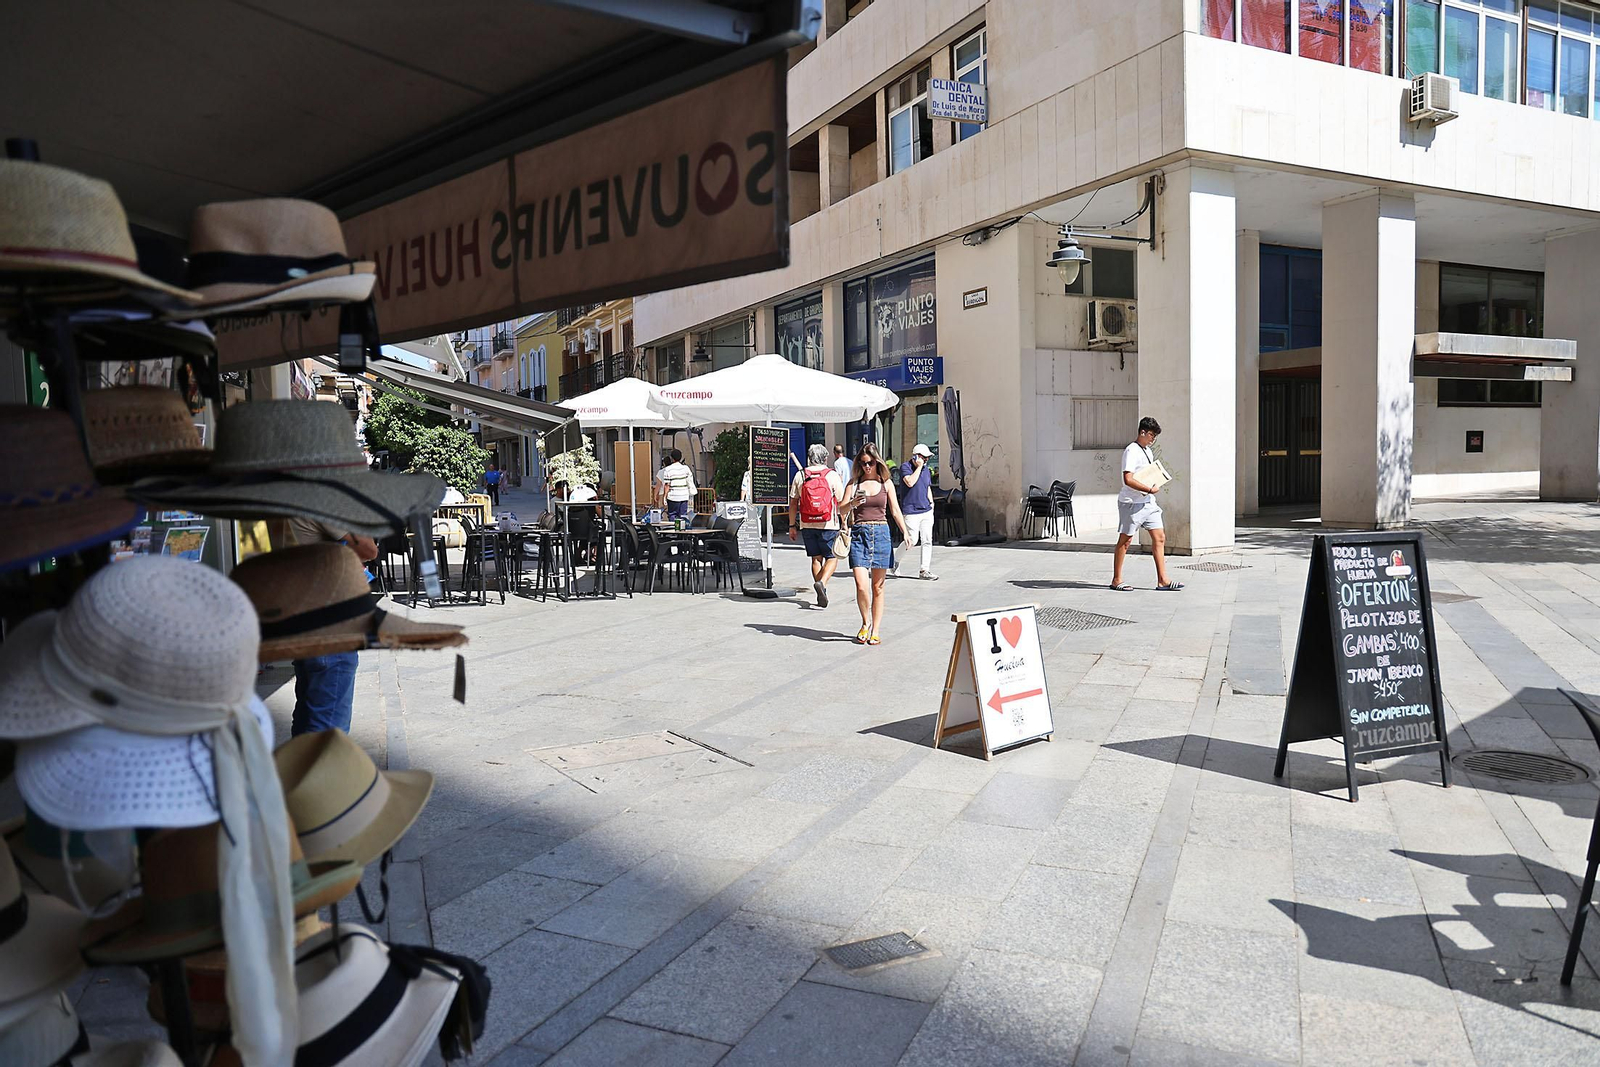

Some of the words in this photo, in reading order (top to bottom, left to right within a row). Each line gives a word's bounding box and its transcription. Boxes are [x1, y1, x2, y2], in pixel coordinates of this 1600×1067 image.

[932, 79, 972, 93] CLINICA
[948, 92, 985, 105] DENTAL
[941, 101, 956, 110] Luis
[958, 104, 967, 112] de
[898, 292, 934, 315] PUNTO
[898, 309, 935, 331] VIAJES
[907, 358, 934, 366] PUNTO
[660, 390, 713, 404] Cruzcampo
[1331, 546, 1357, 559] TODO
[1360, 547, 1374, 558] EL
[1334, 558, 1375, 571] PRODUCTO
[1377, 557, 1388, 567] DE
[1346, 569, 1377, 581] HUELVA
[1341, 579, 1410, 606] OFERTÓN
[1340, 608, 1407, 630] PELOTAZOS
[1408, 610, 1422, 624] DE
[987, 618, 1001, 654] I
[1342, 633, 1397, 658] GAMBAS
[1376, 655, 1391, 667] DE
[1350, 708, 1369, 725] SIN
[1370, 704, 1431, 721] COMPETENCIA
